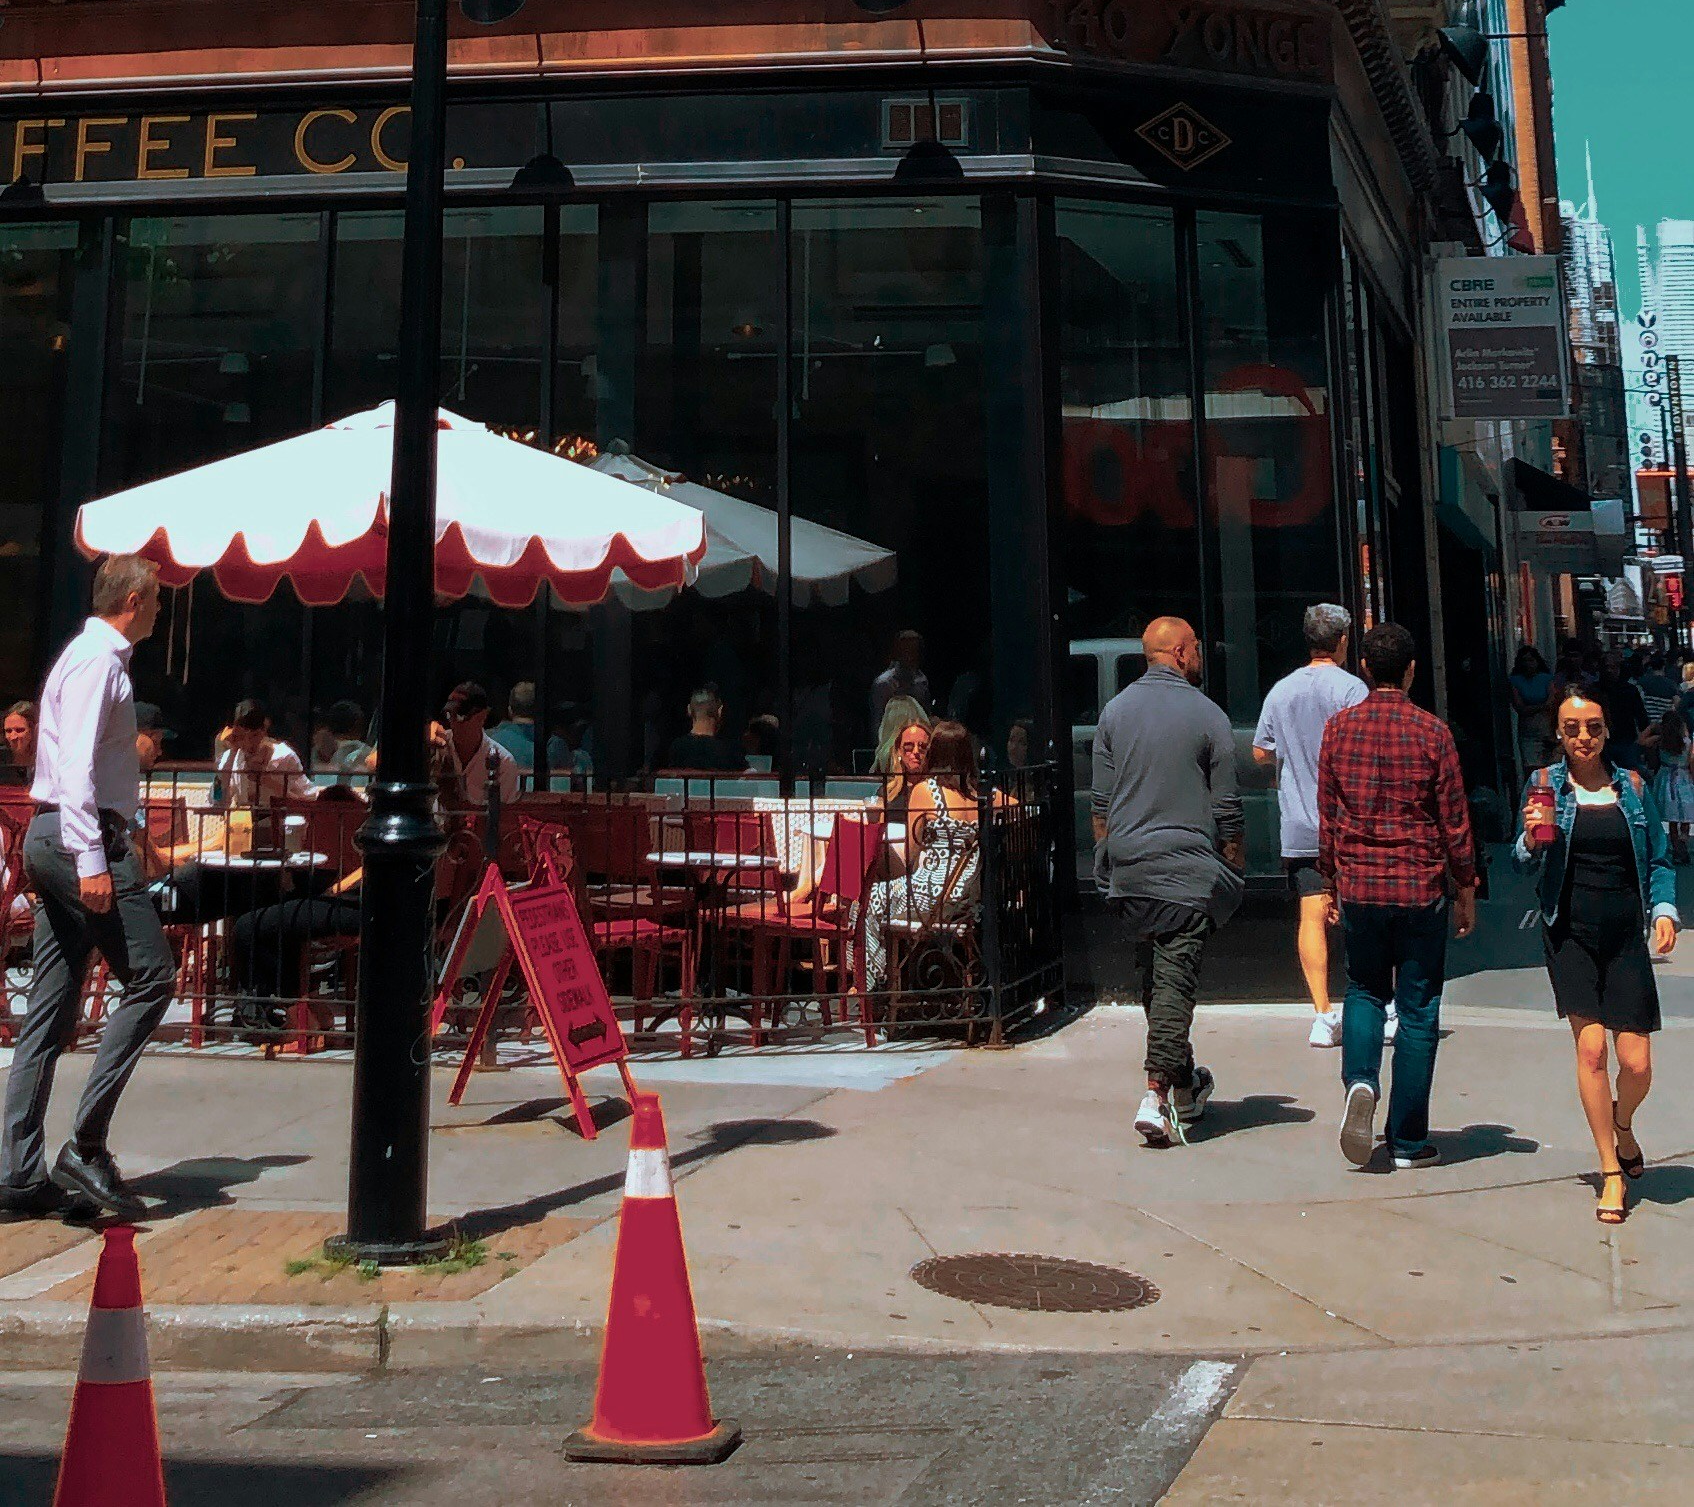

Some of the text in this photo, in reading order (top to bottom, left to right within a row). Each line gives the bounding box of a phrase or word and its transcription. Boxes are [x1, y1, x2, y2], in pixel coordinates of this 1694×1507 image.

[1450, 278, 1495, 292] CBRE
[1450, 296, 1551, 309] ENTIRE PROPERTY
[1452, 311, 1512, 323] AVAILABLE
[1457, 374, 1558, 389] 416 362 2244
